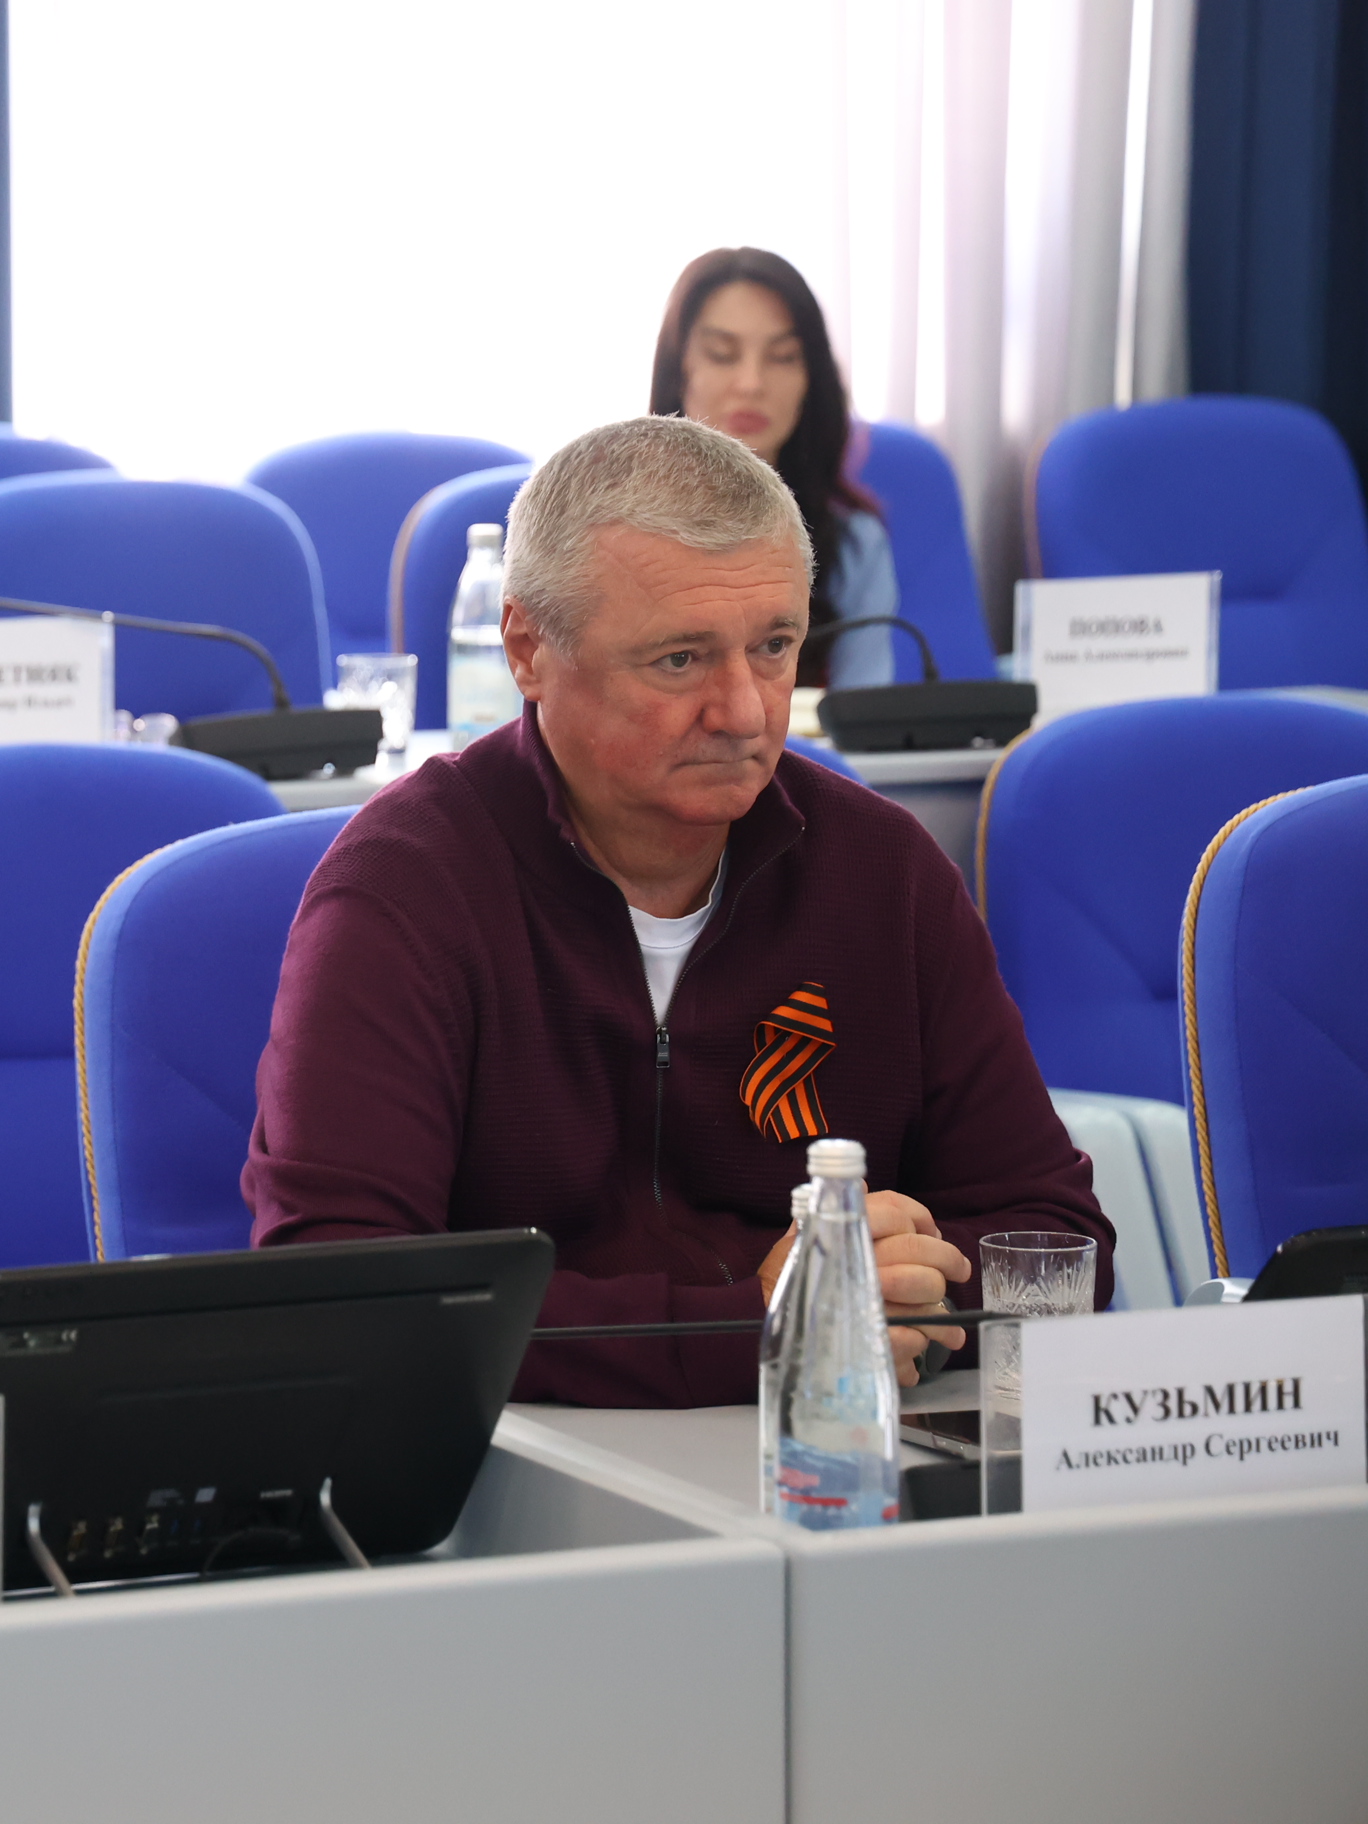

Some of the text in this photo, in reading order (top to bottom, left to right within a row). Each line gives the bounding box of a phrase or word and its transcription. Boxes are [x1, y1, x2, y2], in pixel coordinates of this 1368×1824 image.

[1091, 1376, 1302, 1427] КУЗЬМИН
[1057, 1429, 1340, 1471] Александр Сергеевич
